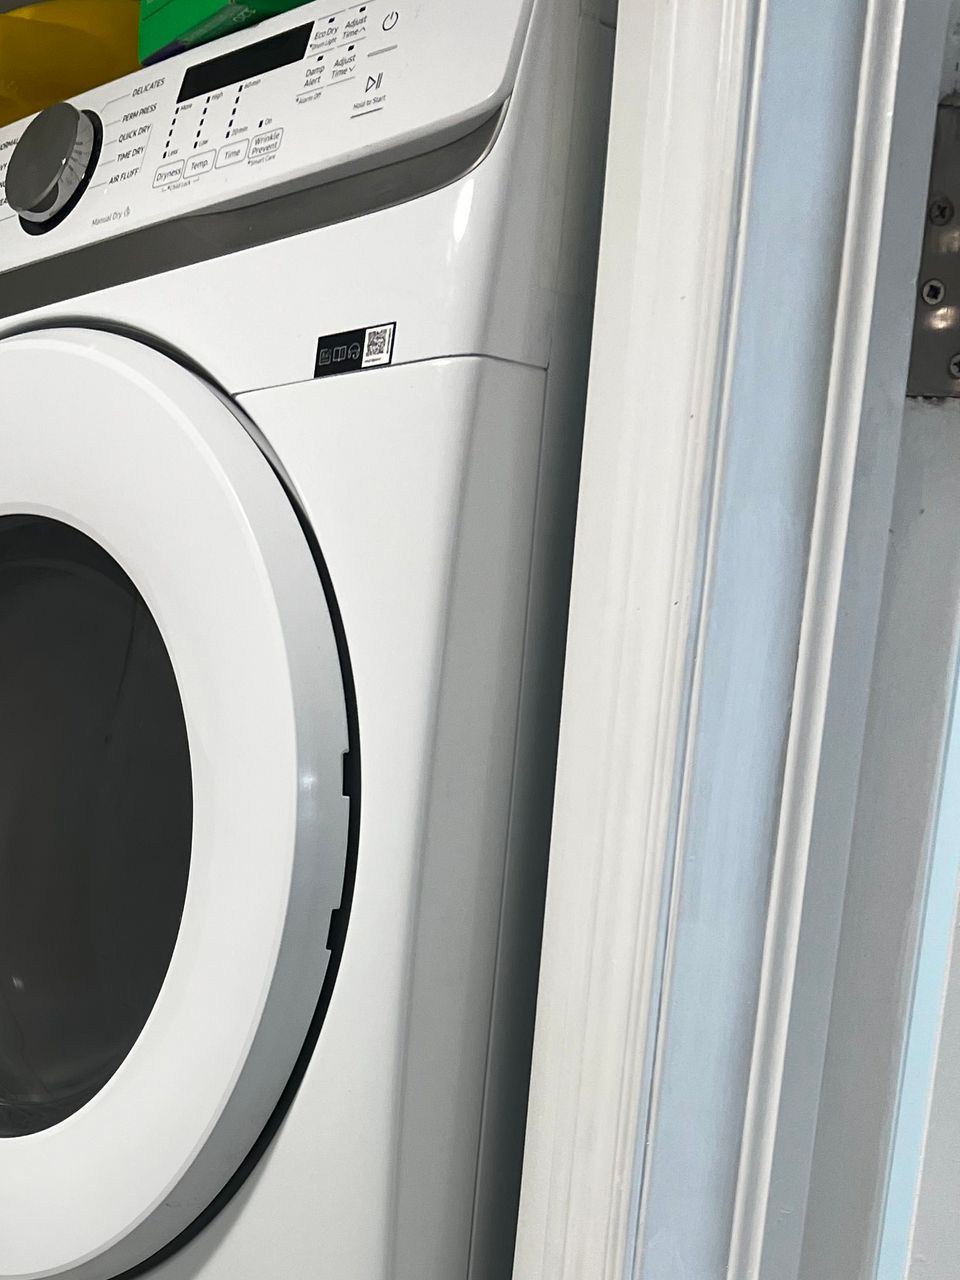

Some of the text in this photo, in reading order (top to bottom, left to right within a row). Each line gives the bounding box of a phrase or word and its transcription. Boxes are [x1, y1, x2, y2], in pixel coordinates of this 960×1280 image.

[345, 16, 368, 29] Adjust
[314, 26, 339, 40] Eco Dry
[342, 28, 359, 39] Time
[334, 54, 356, 68] Adjust
[305, 66, 325, 78] Damp
[332, 67, 348, 79] Time
[132, 77, 166, 98] DELICATES
[304, 76, 322, 88] Alert
[353, 101, 365, 110] Hold
[372, 95, 386, 104] Start
[122, 102, 158, 123] PERM PRESS
[118, 122, 152, 144] QUICK DRY
[254, 131, 280, 146] Wrinkle
[117, 146, 145, 162] TIME DRY
[224, 150, 240, 160] Time
[252, 142, 278, 156] Prevent
[108, 167, 140, 185] AIR FLUFF
[156, 170, 181, 182] Dryness
